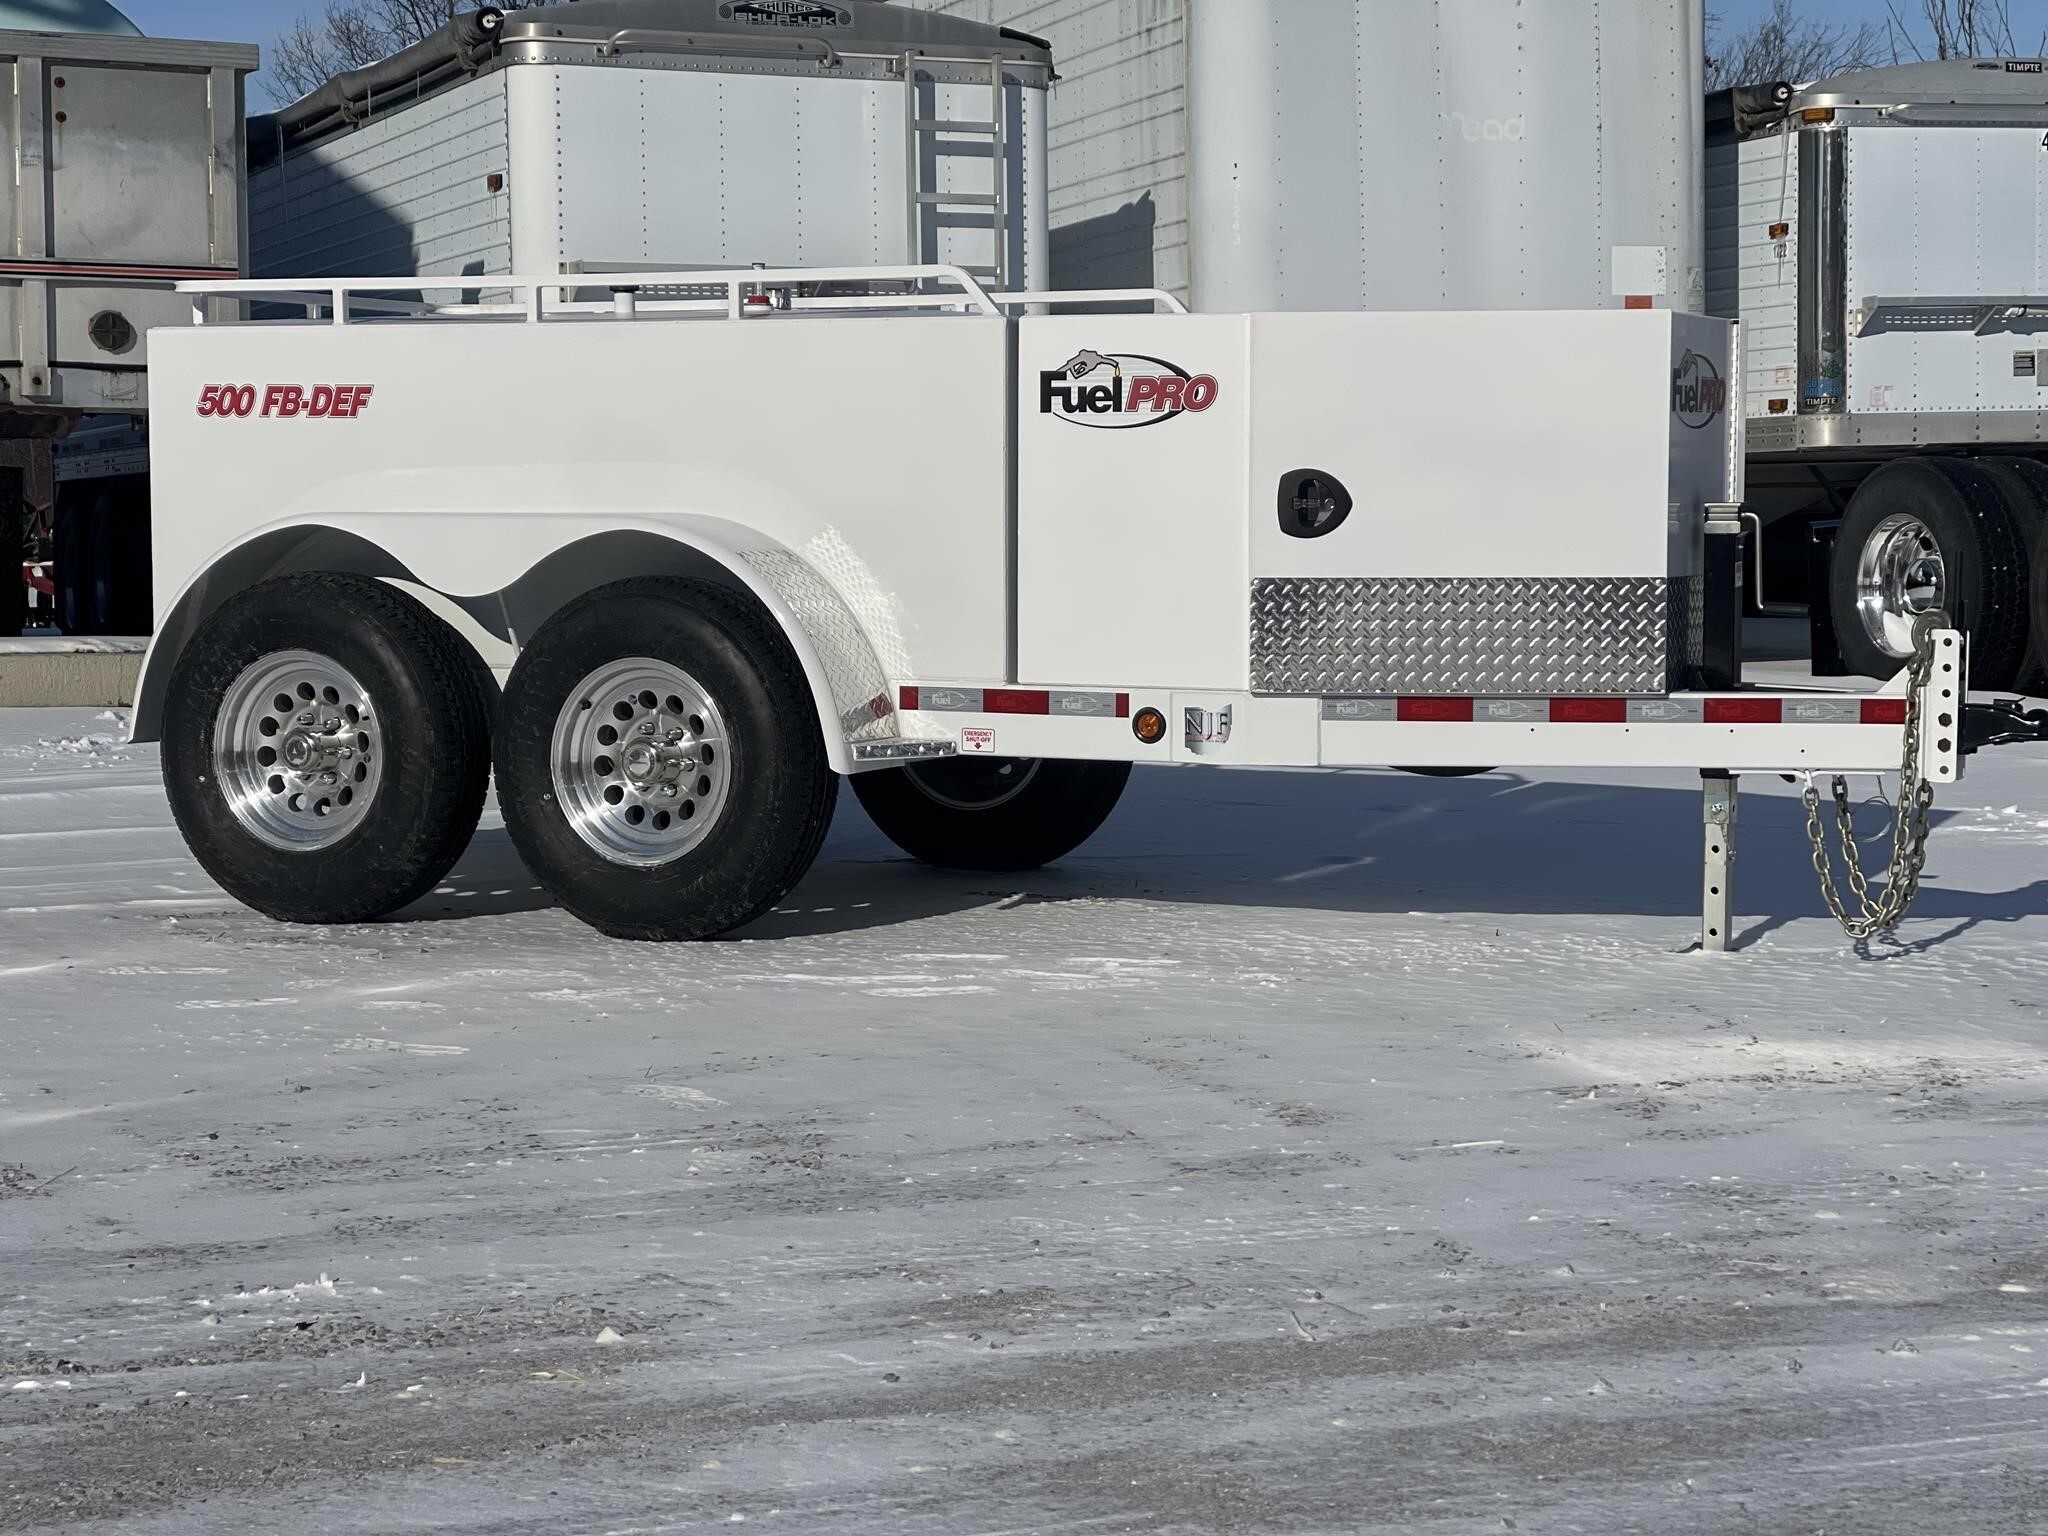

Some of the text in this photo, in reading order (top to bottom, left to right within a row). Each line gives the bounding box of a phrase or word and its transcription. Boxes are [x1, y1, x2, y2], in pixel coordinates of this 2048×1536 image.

[735, 12, 835, 25] SHUR-LOK
[2007, 63, 2040, 72] TIMPTE
[196, 384, 375, 418] 500 FB-DEF
[1806, 397, 1836, 406] TIMPTE
[1184, 711, 1228, 740] NJF
